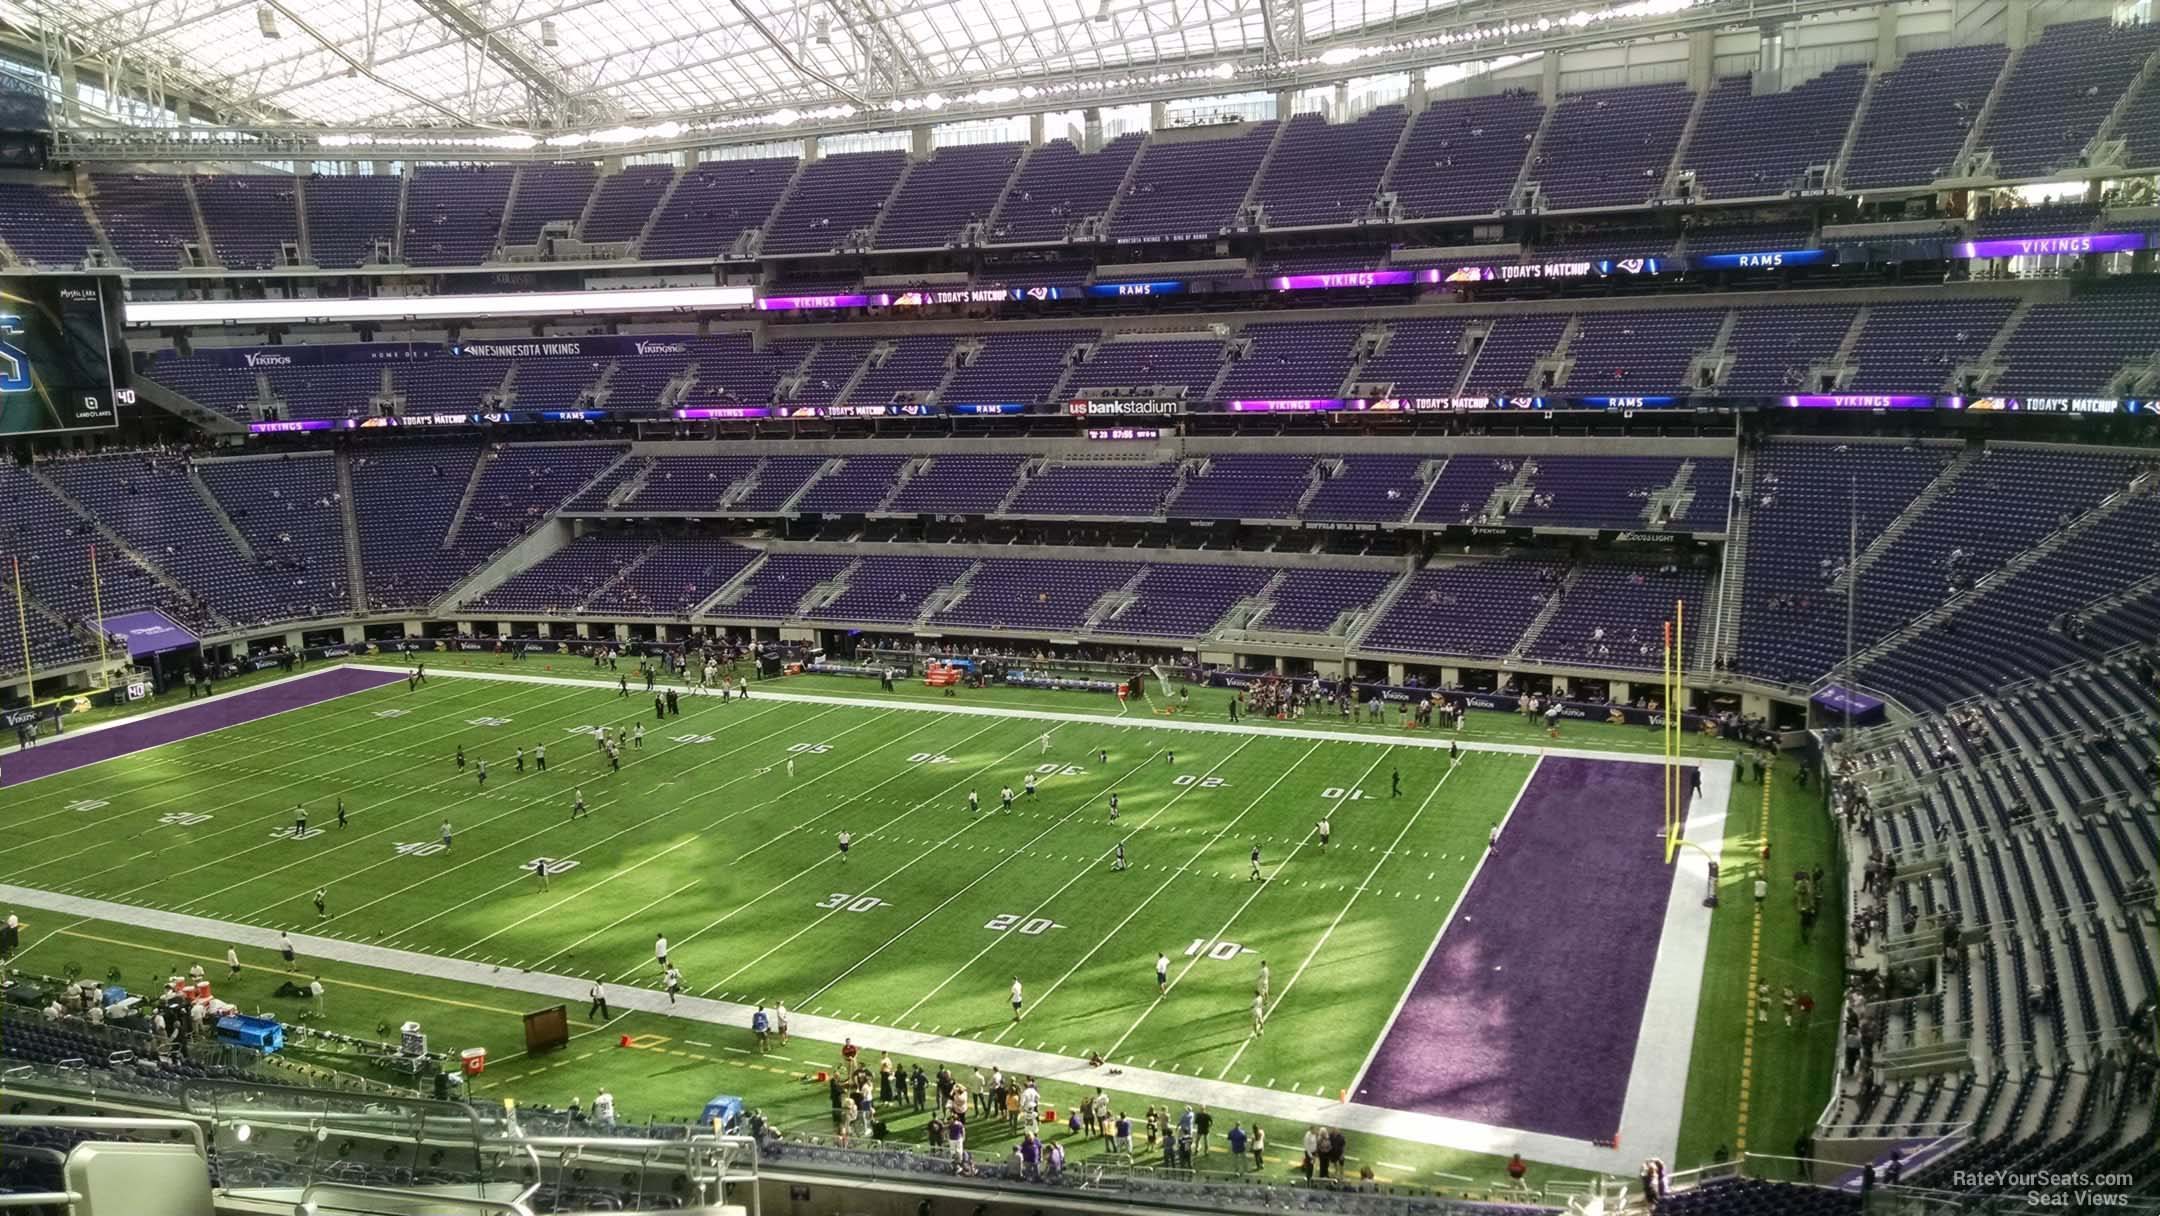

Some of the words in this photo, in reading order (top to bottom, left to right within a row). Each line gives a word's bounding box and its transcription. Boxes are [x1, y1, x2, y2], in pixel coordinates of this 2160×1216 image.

[2022, 238, 2091, 253] VIKINGS
[1740, 254, 1783, 267] RAMS
[1502, 265, 1541, 278] TODAY'S
[1545, 262, 1591, 277] MATCHUP
[1321, 273, 1375, 286] VIKINGS
[937, 291, 969, 303] TODAY'S
[972, 289, 1008, 302] MATCHUP
[1119, 285, 1151, 296] RAMS
[794, 298, 837, 307] VIKINGS
[542, 343, 580, 355] VIKINGS
[117, 390, 136, 404] 40
[1416, 398, 1449, 408] TODAY'S
[1452, 398, 1490, 409] MATCHUP
[1609, 398, 1644, 407] RAMS
[1835, 396, 1890, 407] VIKINGS
[828, 406, 854, 416] TODAY'S
[855, 406, 886, 416] MATCHUP
[976, 404, 1002, 413] RAMS
[1269, 400, 1311, 410] VIKINGS
[2026, 398, 2068, 411] TODAY'S
[2072, 400, 2118, 413] MATCHUP
[560, 412, 585, 420] RAMS
[709, 408, 744, 417] VIKINGS
[402, 415, 432, 425] TODAY'S
[434, 414, 467, 425] MATCHUP
[260, 423, 303, 431] VIKINGS
[1036, 763, 1086, 776] 30
[1173, 775, 1225, 788] 20
[1321, 787, 1367, 801] 10
[157, 811, 214, 825] 20
[816, 893, 883, 913] 30
[984, 914, 1054, 935] 20
[1184, 938, 1244, 961] 10
